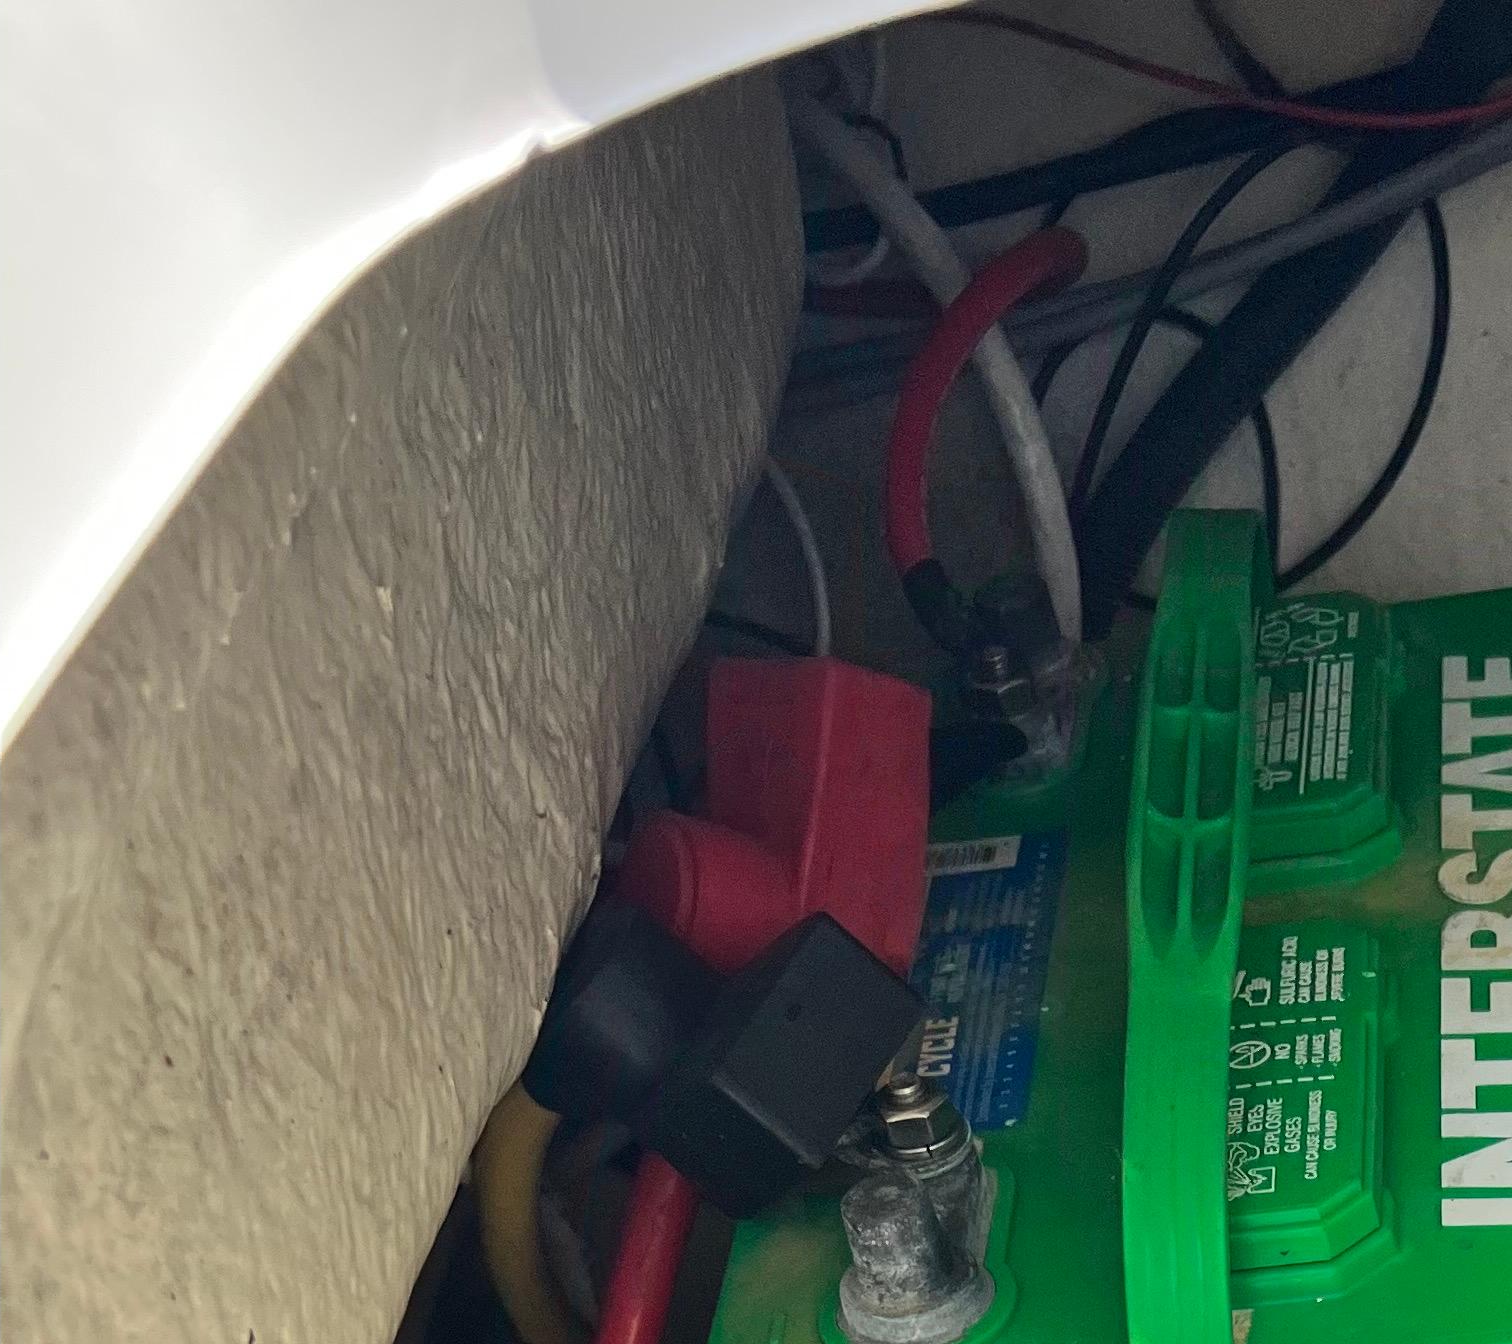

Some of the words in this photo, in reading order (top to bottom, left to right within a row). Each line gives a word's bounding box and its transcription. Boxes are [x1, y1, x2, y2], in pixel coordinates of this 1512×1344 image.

[917, 1015, 959, 1077] CYCLE
[1274, 1043, 1291, 1060] NO
[1228, 1098, 1245, 1135] SHIELD
[1247, 1104, 1265, 1132] EYES
[1264, 1097, 1283, 1155] EXPLOSIVE
[1284, 1116, 1302, 1153] GASES
